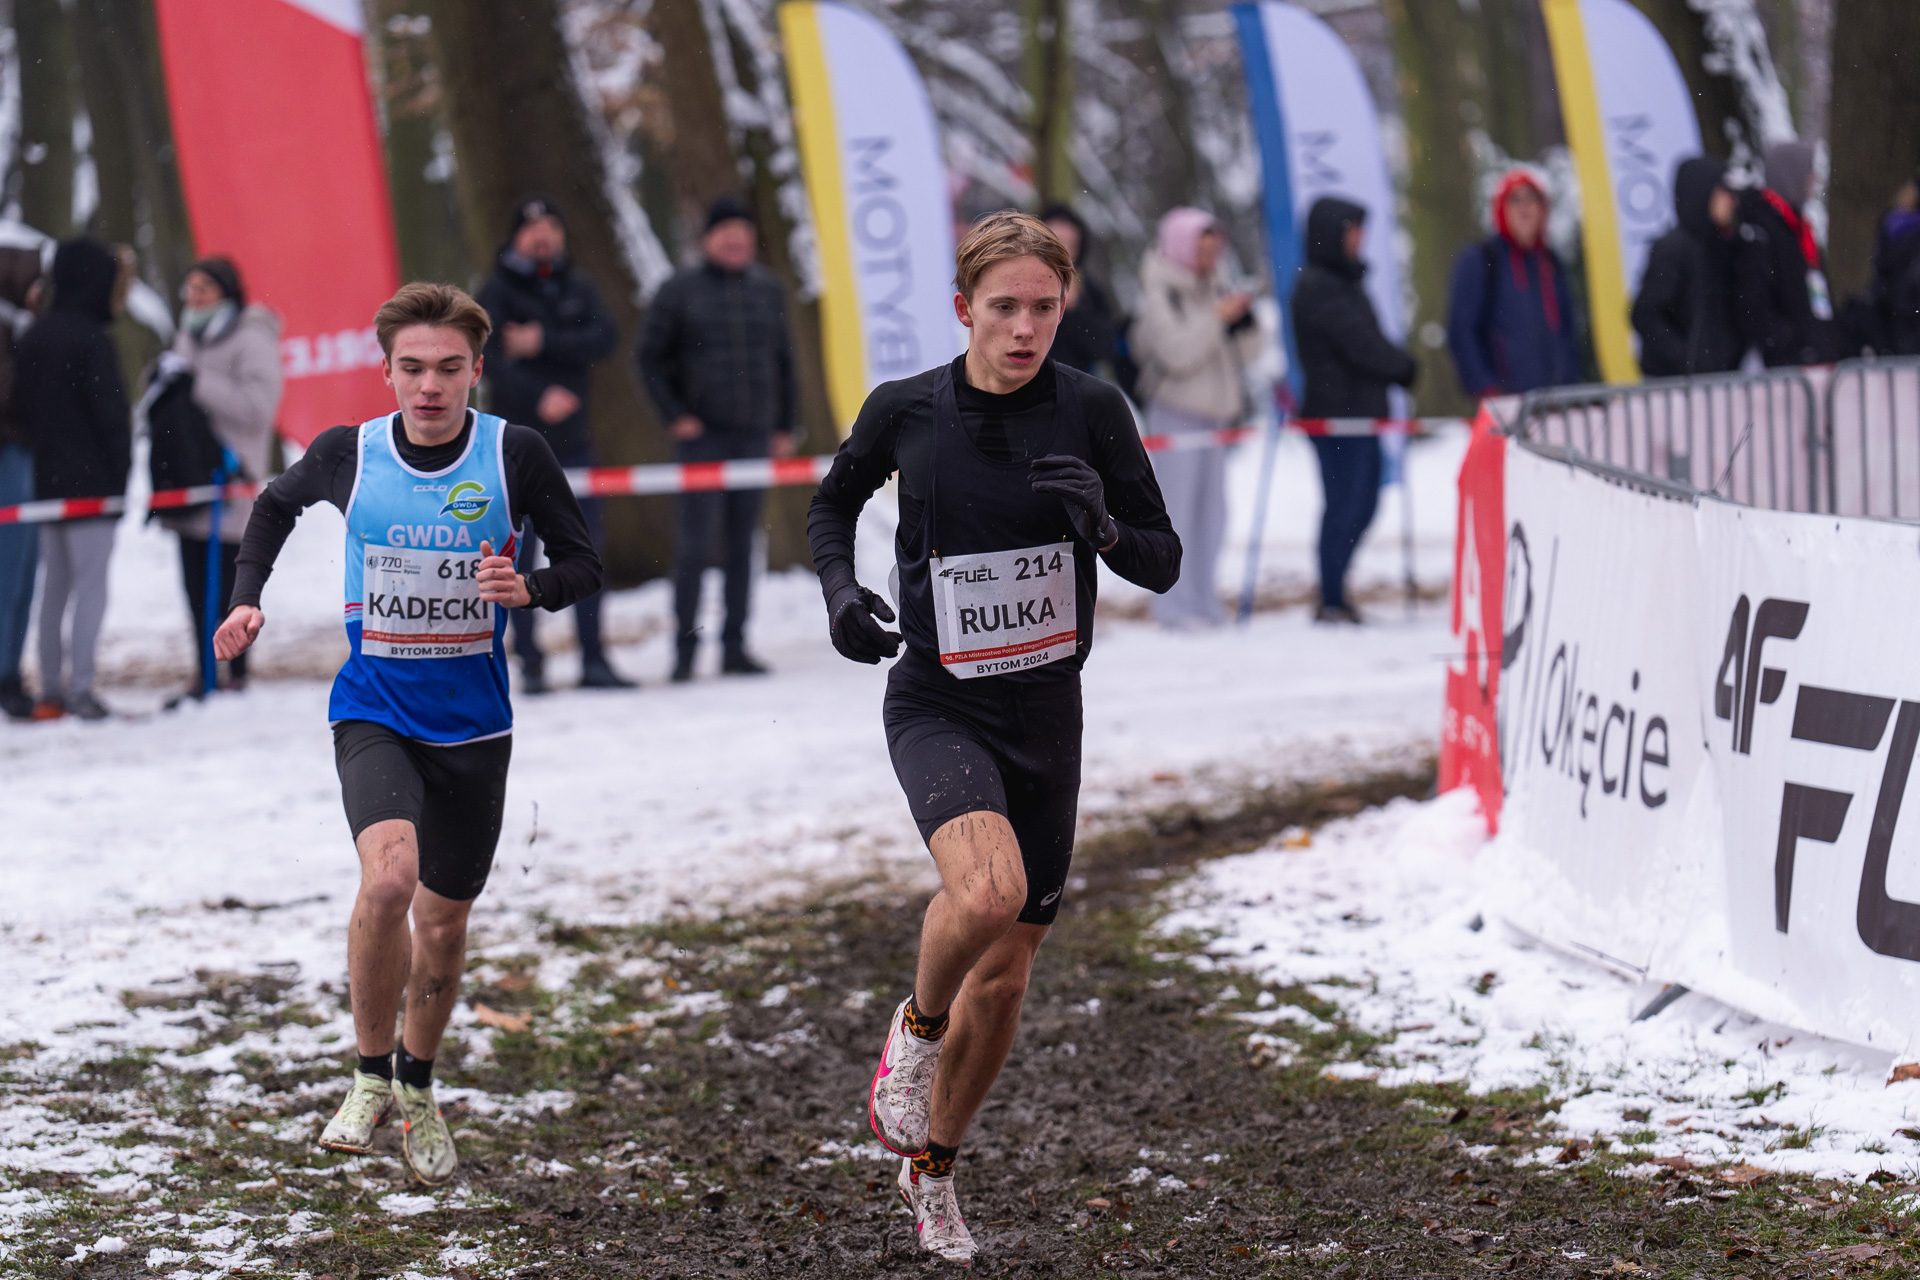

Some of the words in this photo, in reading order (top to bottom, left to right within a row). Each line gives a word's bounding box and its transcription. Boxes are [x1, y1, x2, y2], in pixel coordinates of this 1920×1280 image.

[386, 524, 472, 547] GWDA
[381, 556, 402, 568] 770
[438, 558, 482, 580] 618
[954, 568, 1000, 584] FUEL
[1014, 551, 1063, 581] 214
[369, 592, 488, 620] KADECKI
[960, 596, 1056, 635] RULKA
[391, 646, 432, 656] BYTOM
[435, 646, 463, 655] 2024
[976, 659, 1021, 674] BYTOM
[1023, 651, 1049, 666] 2024
[1541, 641, 1670, 819] Okęcie
